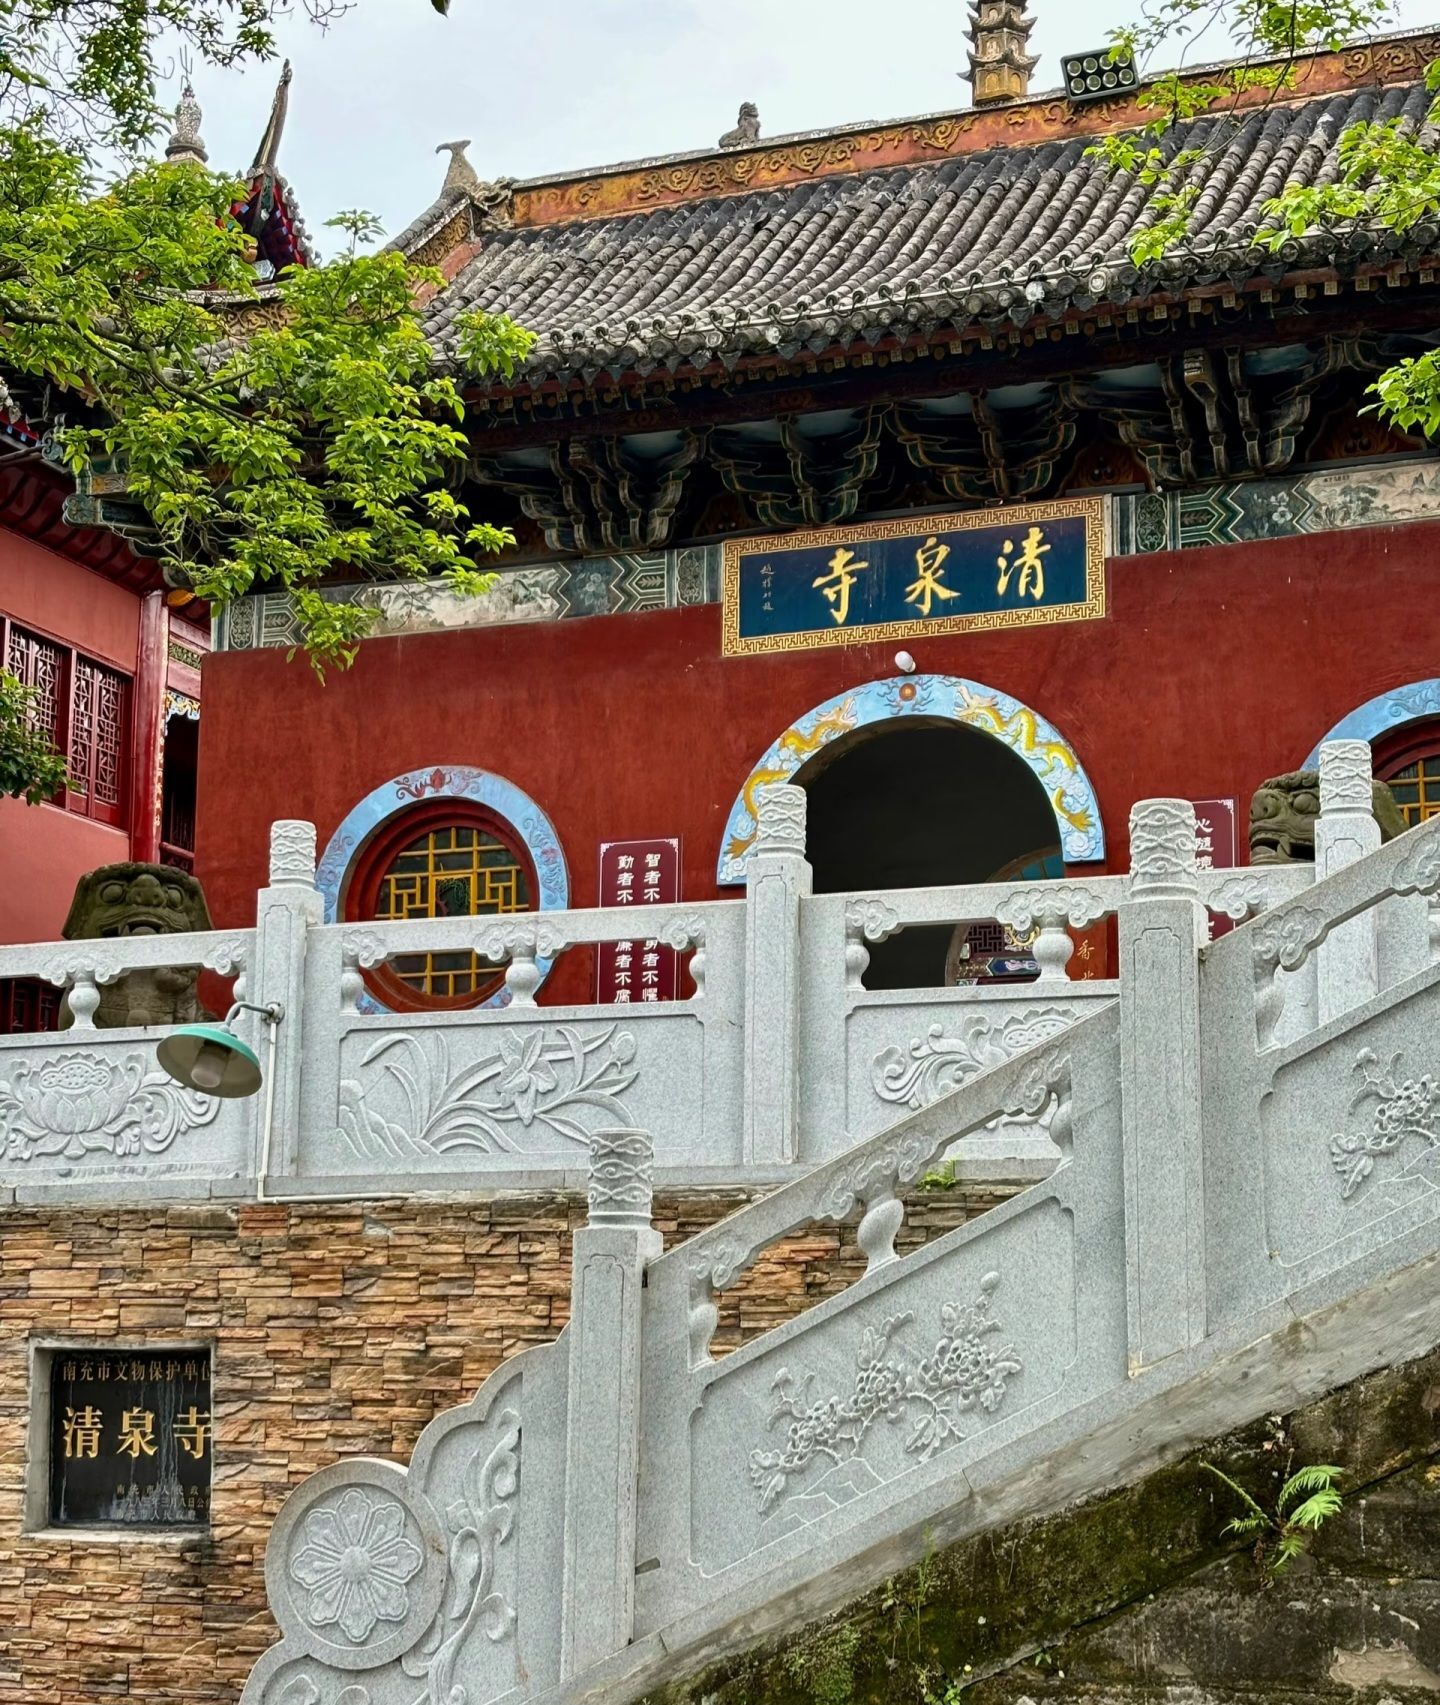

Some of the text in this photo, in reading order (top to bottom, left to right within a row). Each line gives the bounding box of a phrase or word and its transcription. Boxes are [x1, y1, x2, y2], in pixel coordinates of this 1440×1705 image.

[812, 526, 1052, 625] 清泉寺
[643, 853, 661, 902] 智者不
[62, 1359, 211, 1382] 南充市文物保护单位
[62, 1405, 211, 1460] 清泉寺
